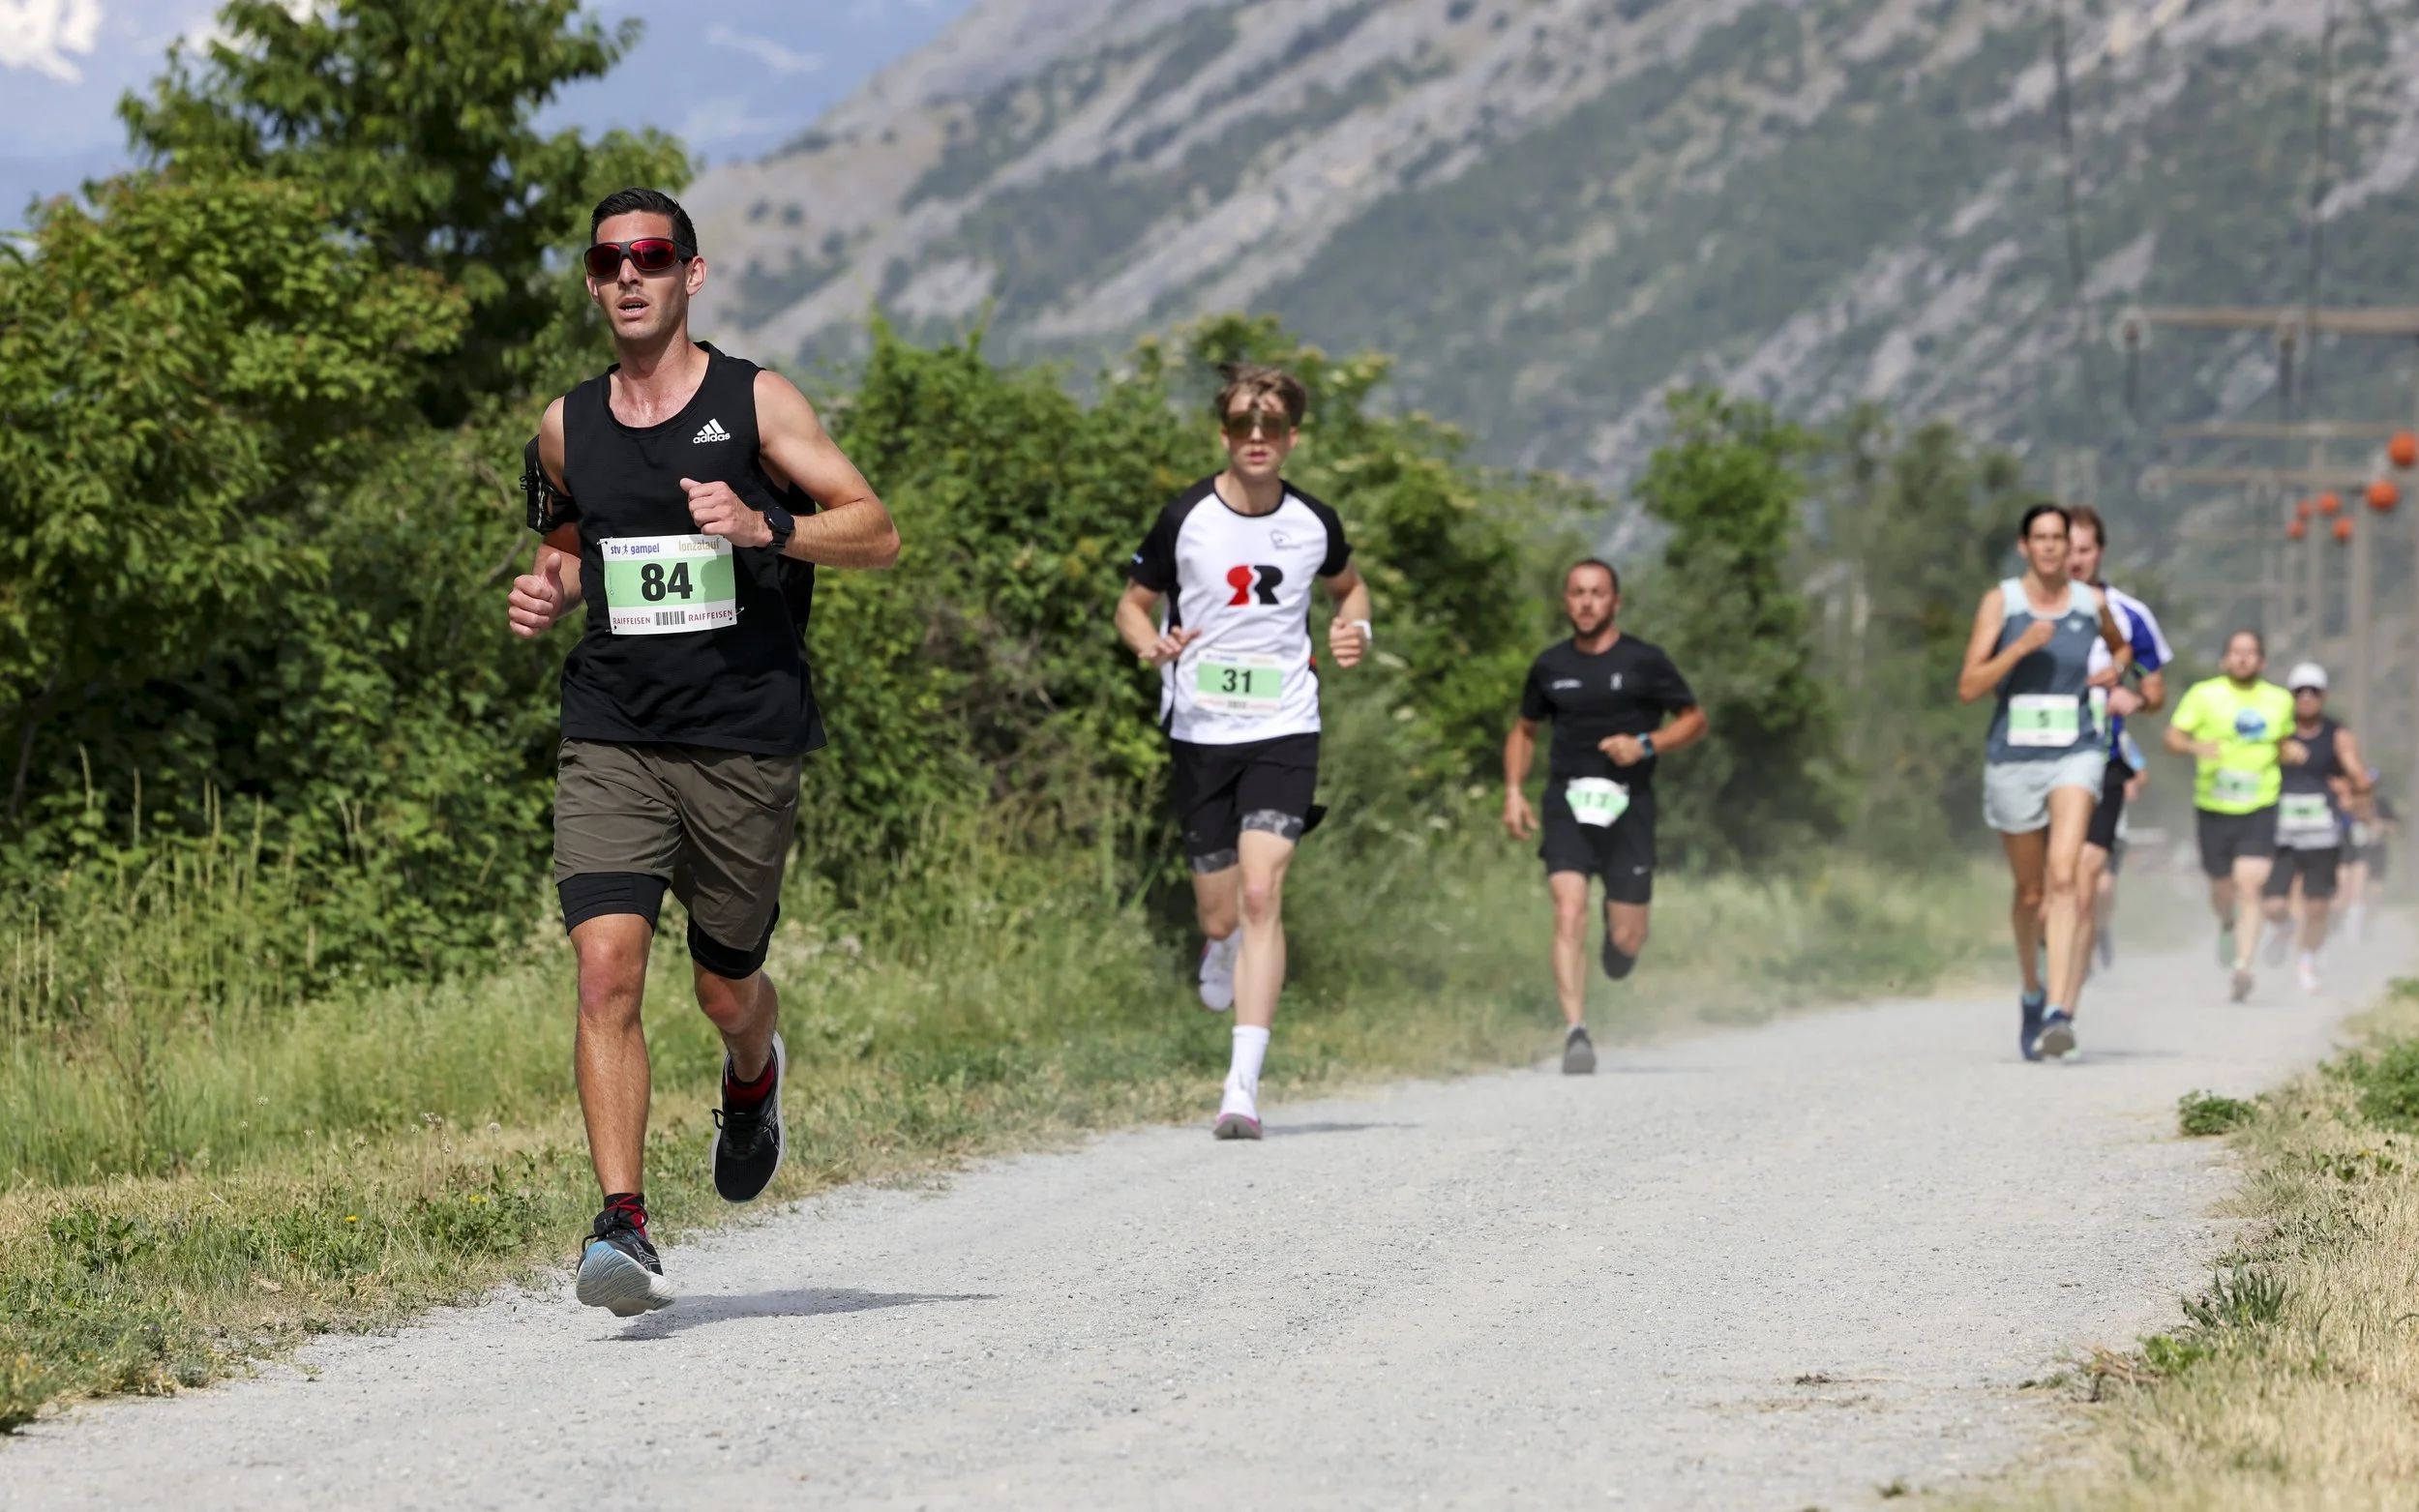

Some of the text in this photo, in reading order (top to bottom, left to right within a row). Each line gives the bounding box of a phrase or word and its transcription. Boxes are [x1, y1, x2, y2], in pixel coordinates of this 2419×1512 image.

[693, 432, 732, 444] adidas
[611, 544, 660, 554] stv gampel
[679, 539, 720, 551] lonzalauf
[641, 562, 693, 602] 84
[612, 609, 732, 625] RAIFFEISEN RAIFFEISEN
[1221, 668, 1252, 694] 31
